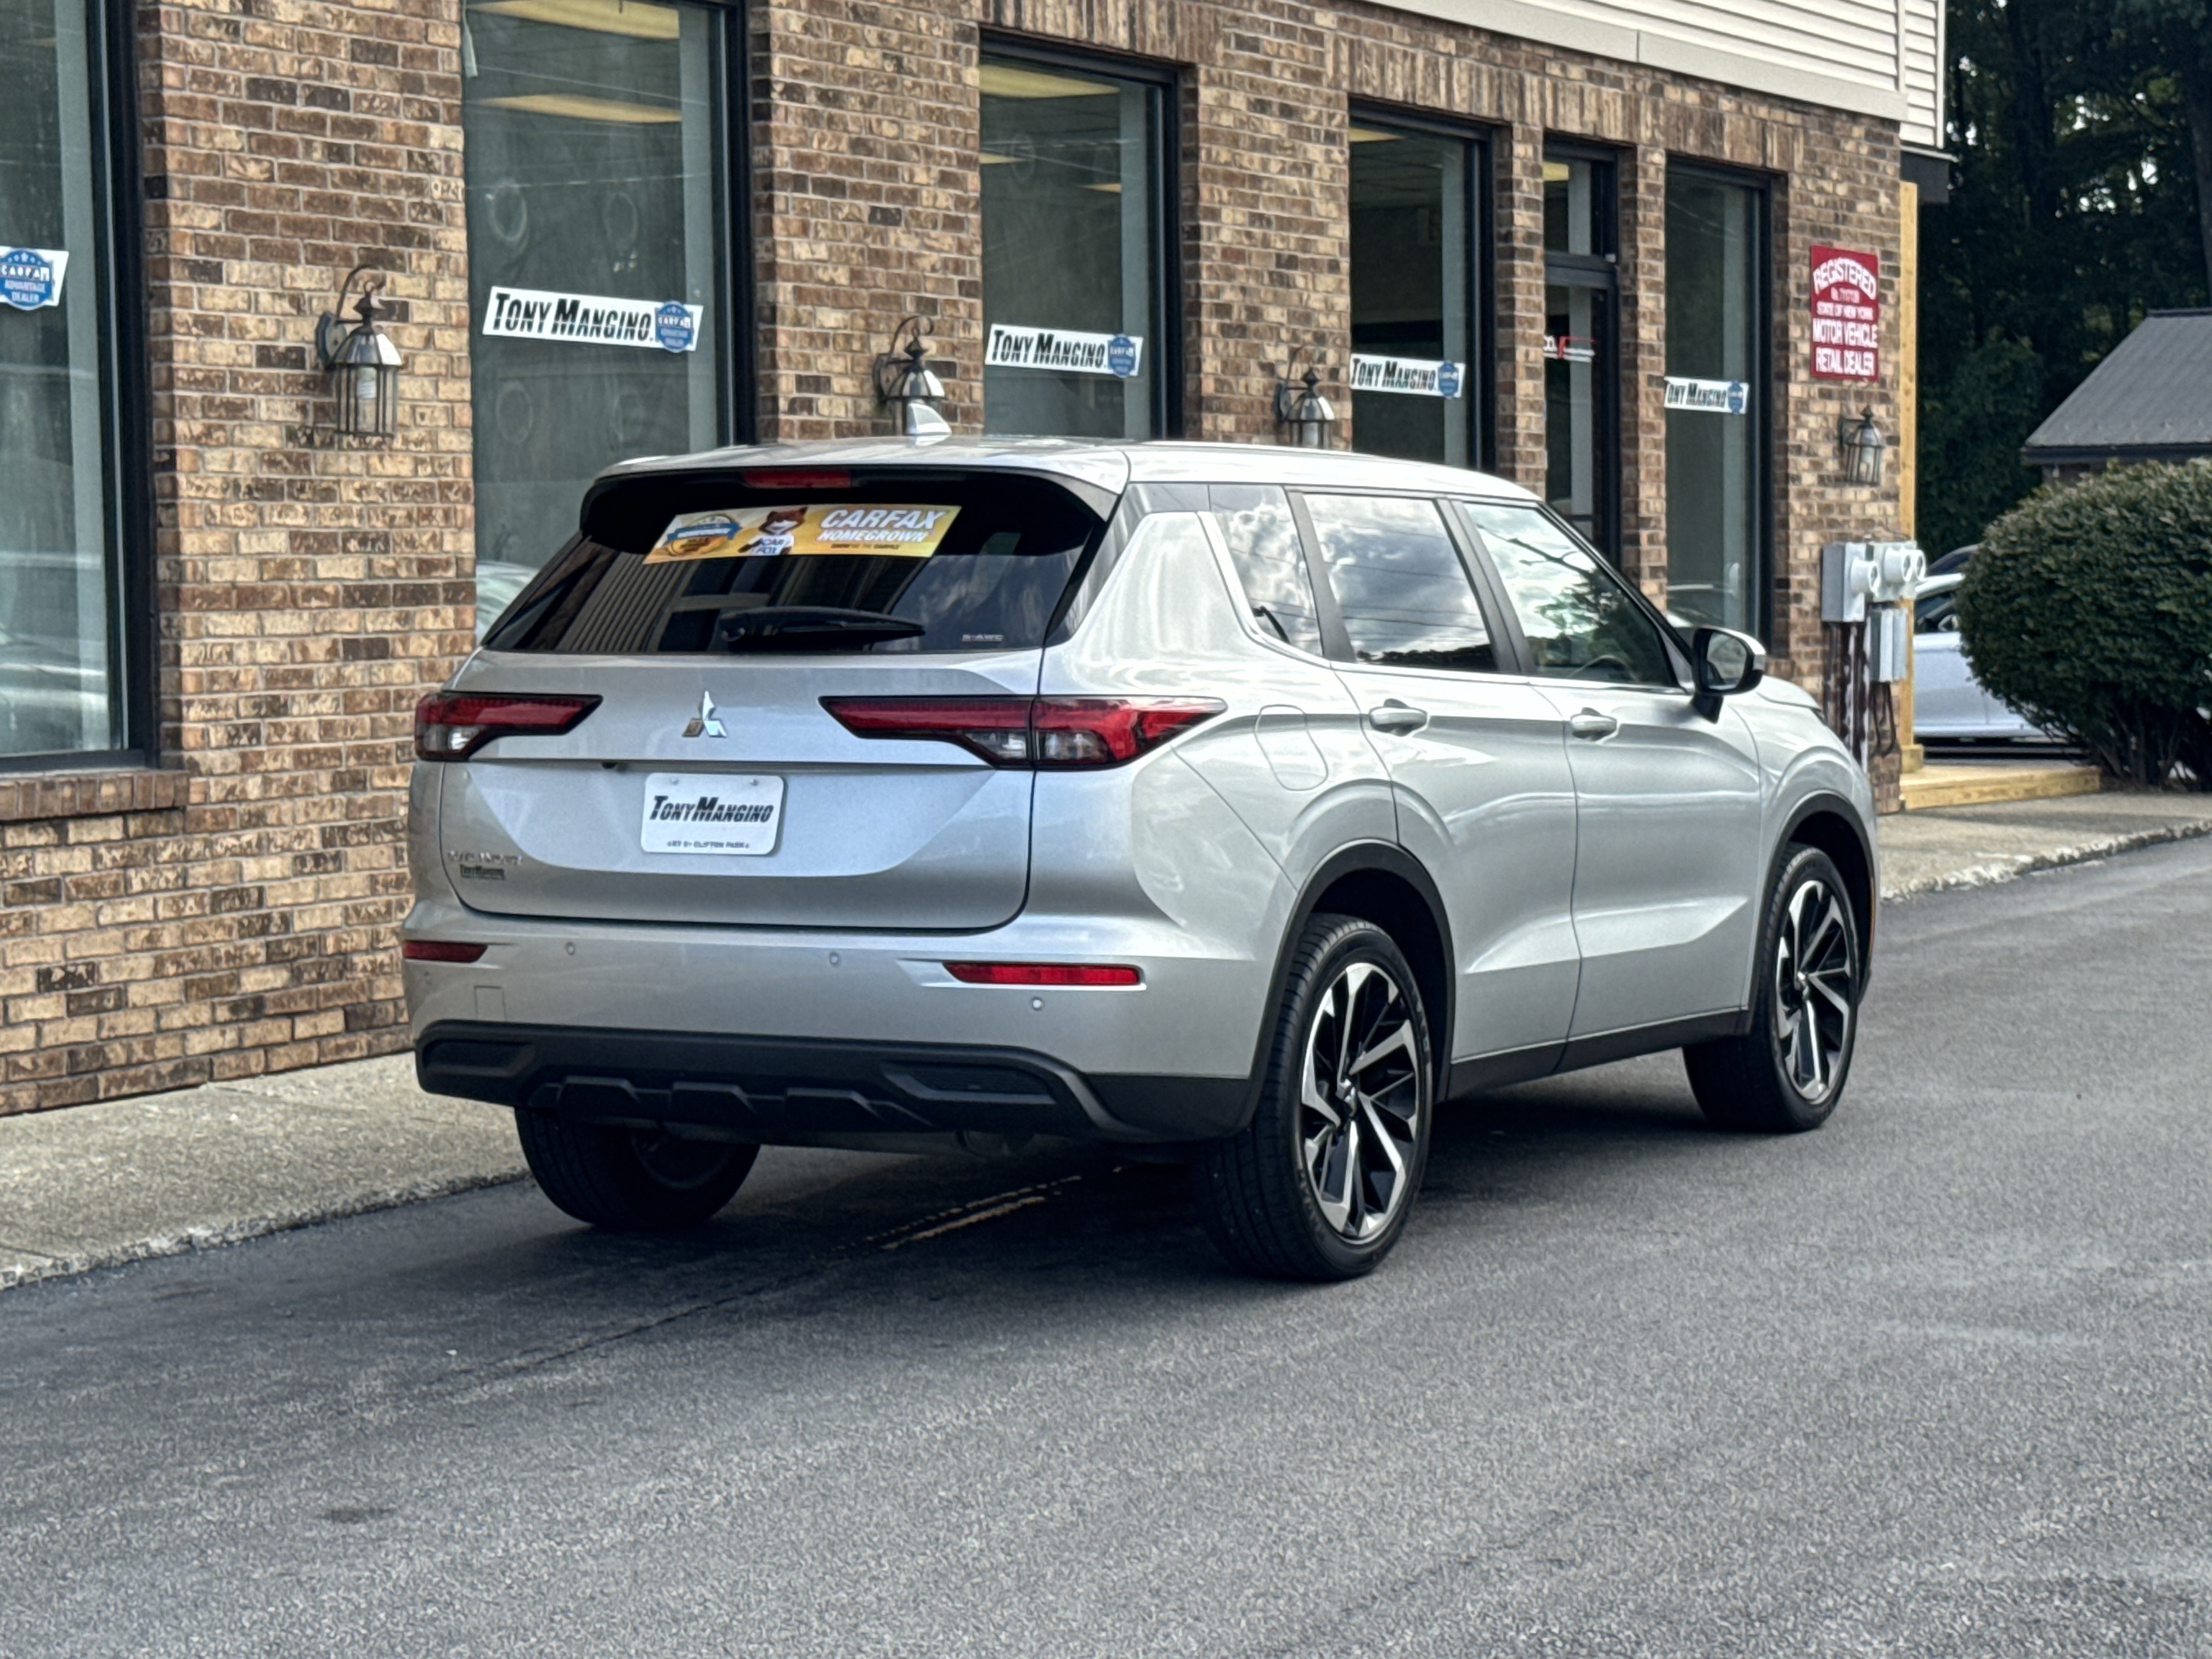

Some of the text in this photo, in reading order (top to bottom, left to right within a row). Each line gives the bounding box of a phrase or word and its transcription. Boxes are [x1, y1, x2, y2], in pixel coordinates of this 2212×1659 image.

[1813, 257, 1877, 301] REGISTERED
[493, 292, 552, 334] TONY
[991, 329, 1034, 363] TONY
[1813, 318, 1878, 349] MOTOR VEHICLE
[1351, 358, 1383, 387] TONY
[1815, 346, 1876, 376] RETAIL DEALER
[820, 509, 946, 530] CARFAX
[816, 529, 928, 543] HOMEGROWN
